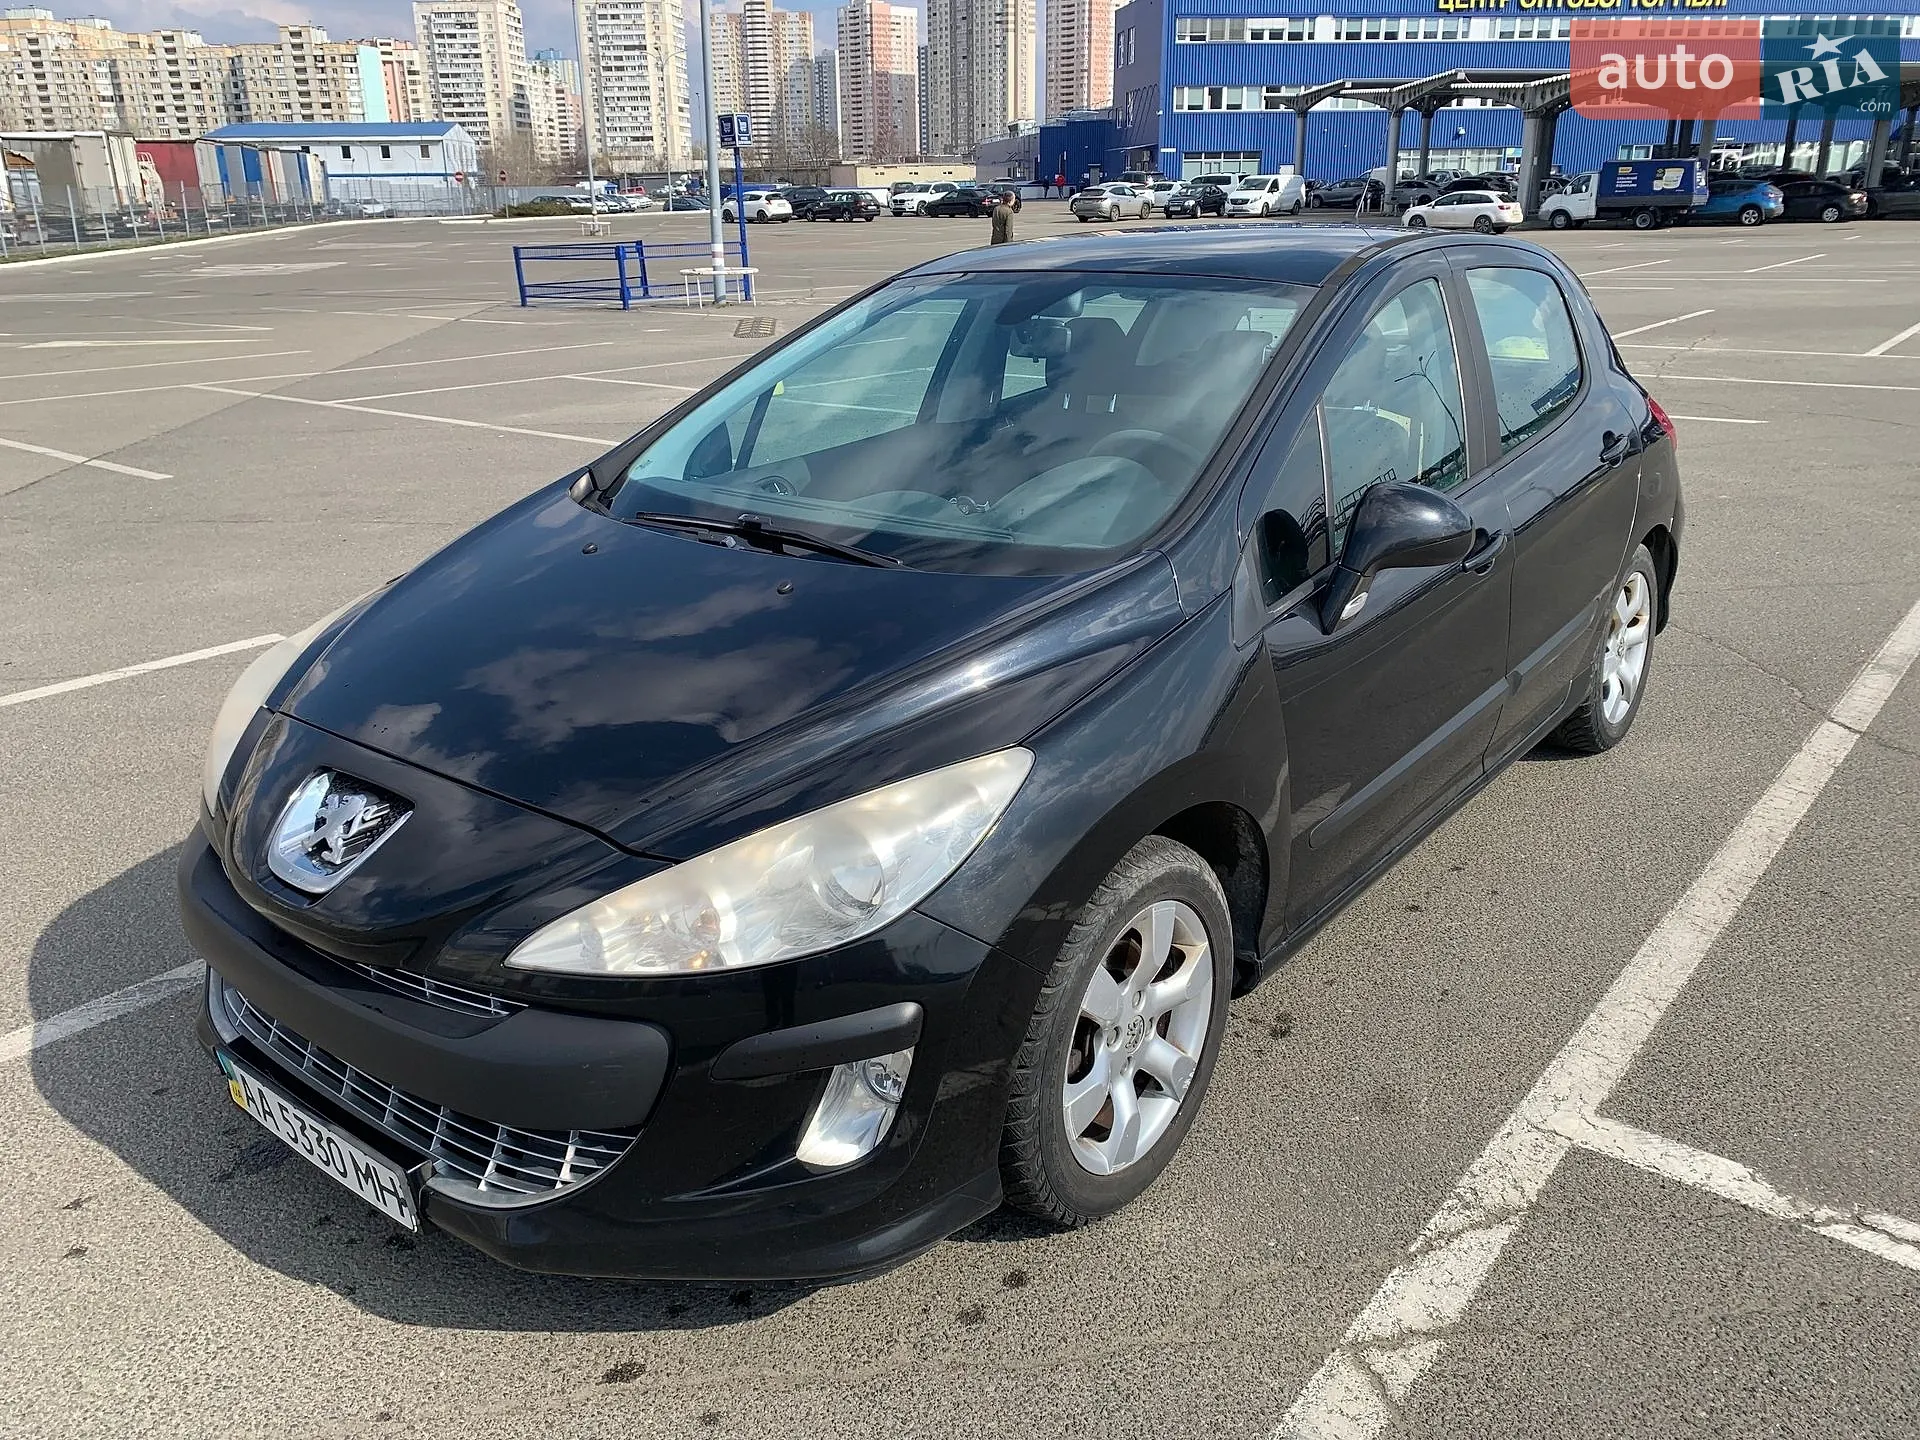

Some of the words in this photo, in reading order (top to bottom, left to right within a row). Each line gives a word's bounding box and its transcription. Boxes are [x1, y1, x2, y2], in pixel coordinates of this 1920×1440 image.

[240, 1073, 280, 1132] AA
[277, 1101, 348, 1179] 5330
[348, 1149, 405, 1218] MH
